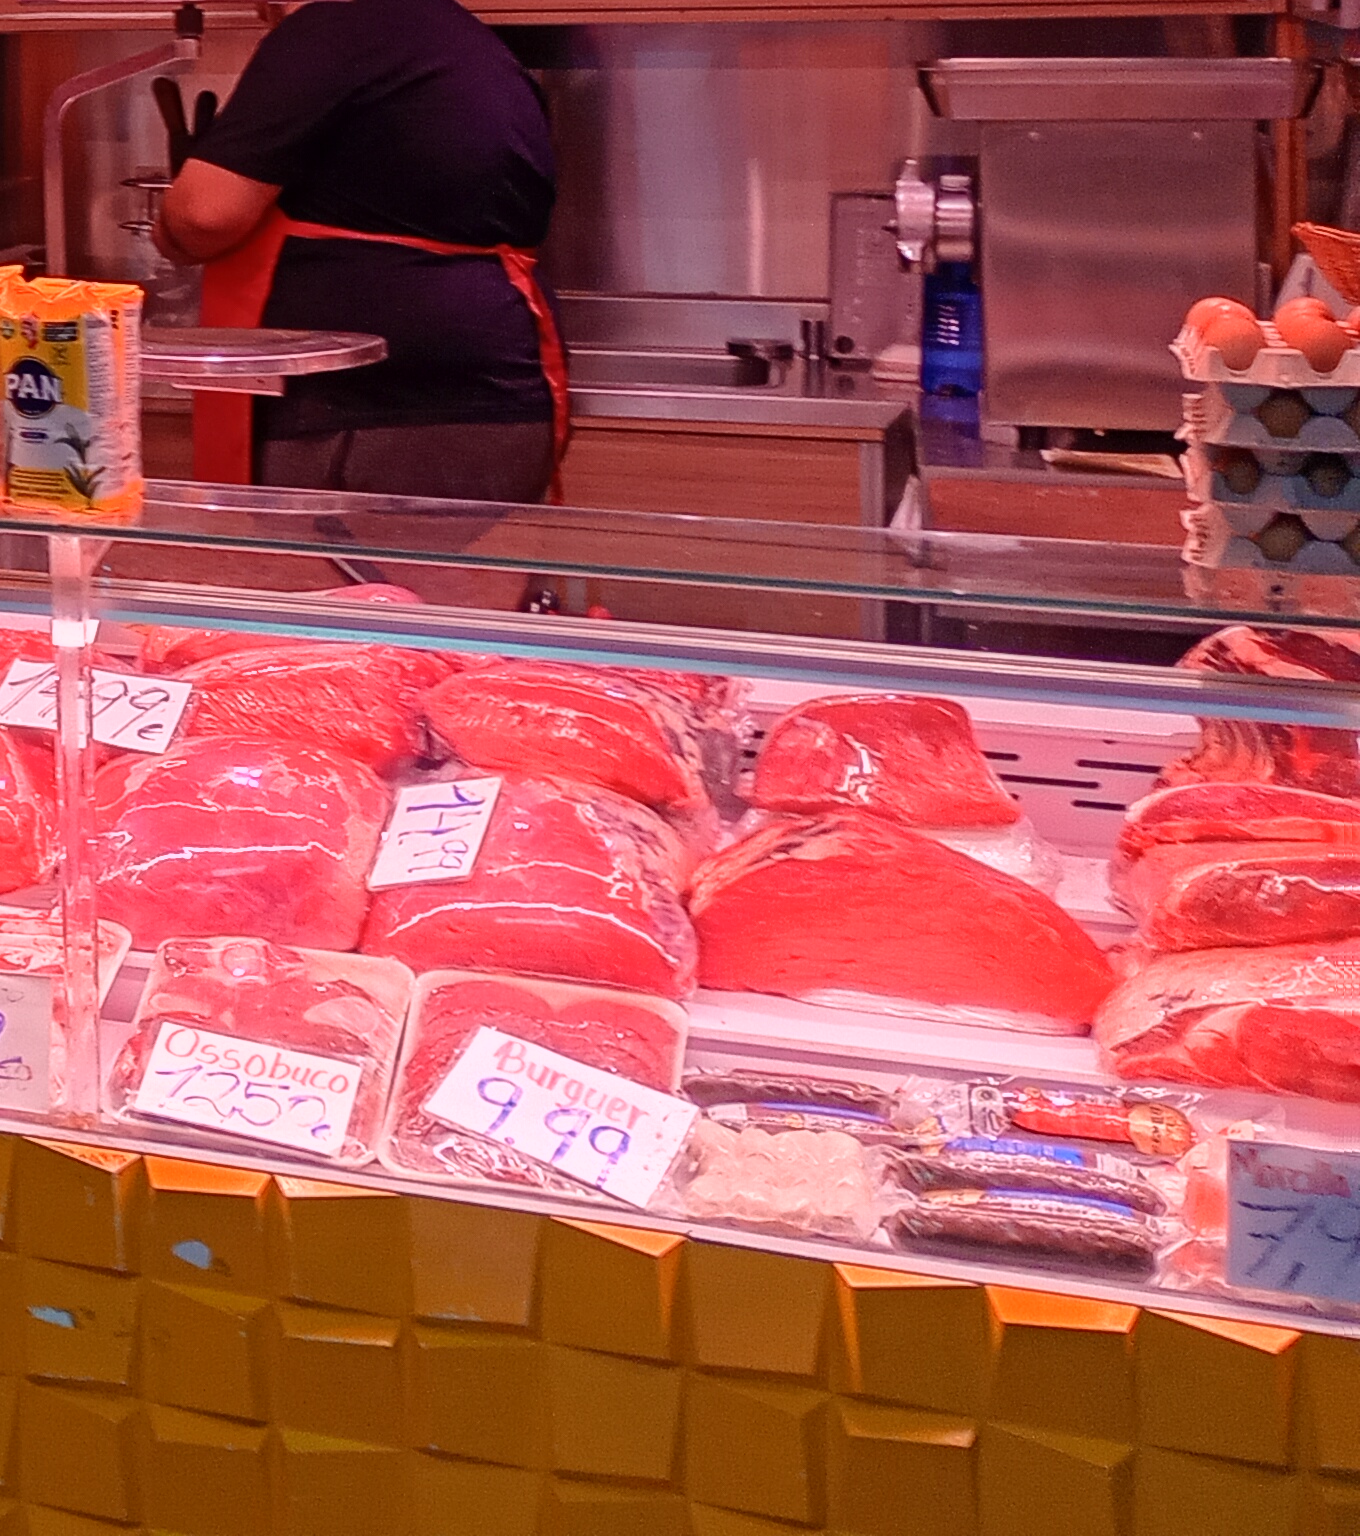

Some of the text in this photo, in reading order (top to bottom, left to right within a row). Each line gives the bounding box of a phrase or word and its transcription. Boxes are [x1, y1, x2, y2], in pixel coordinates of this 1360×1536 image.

[4, 373, 63, 404] PAN
[164, 1028, 350, 1094] Ossobuco
[493, 1039, 650, 1131] Burguer
